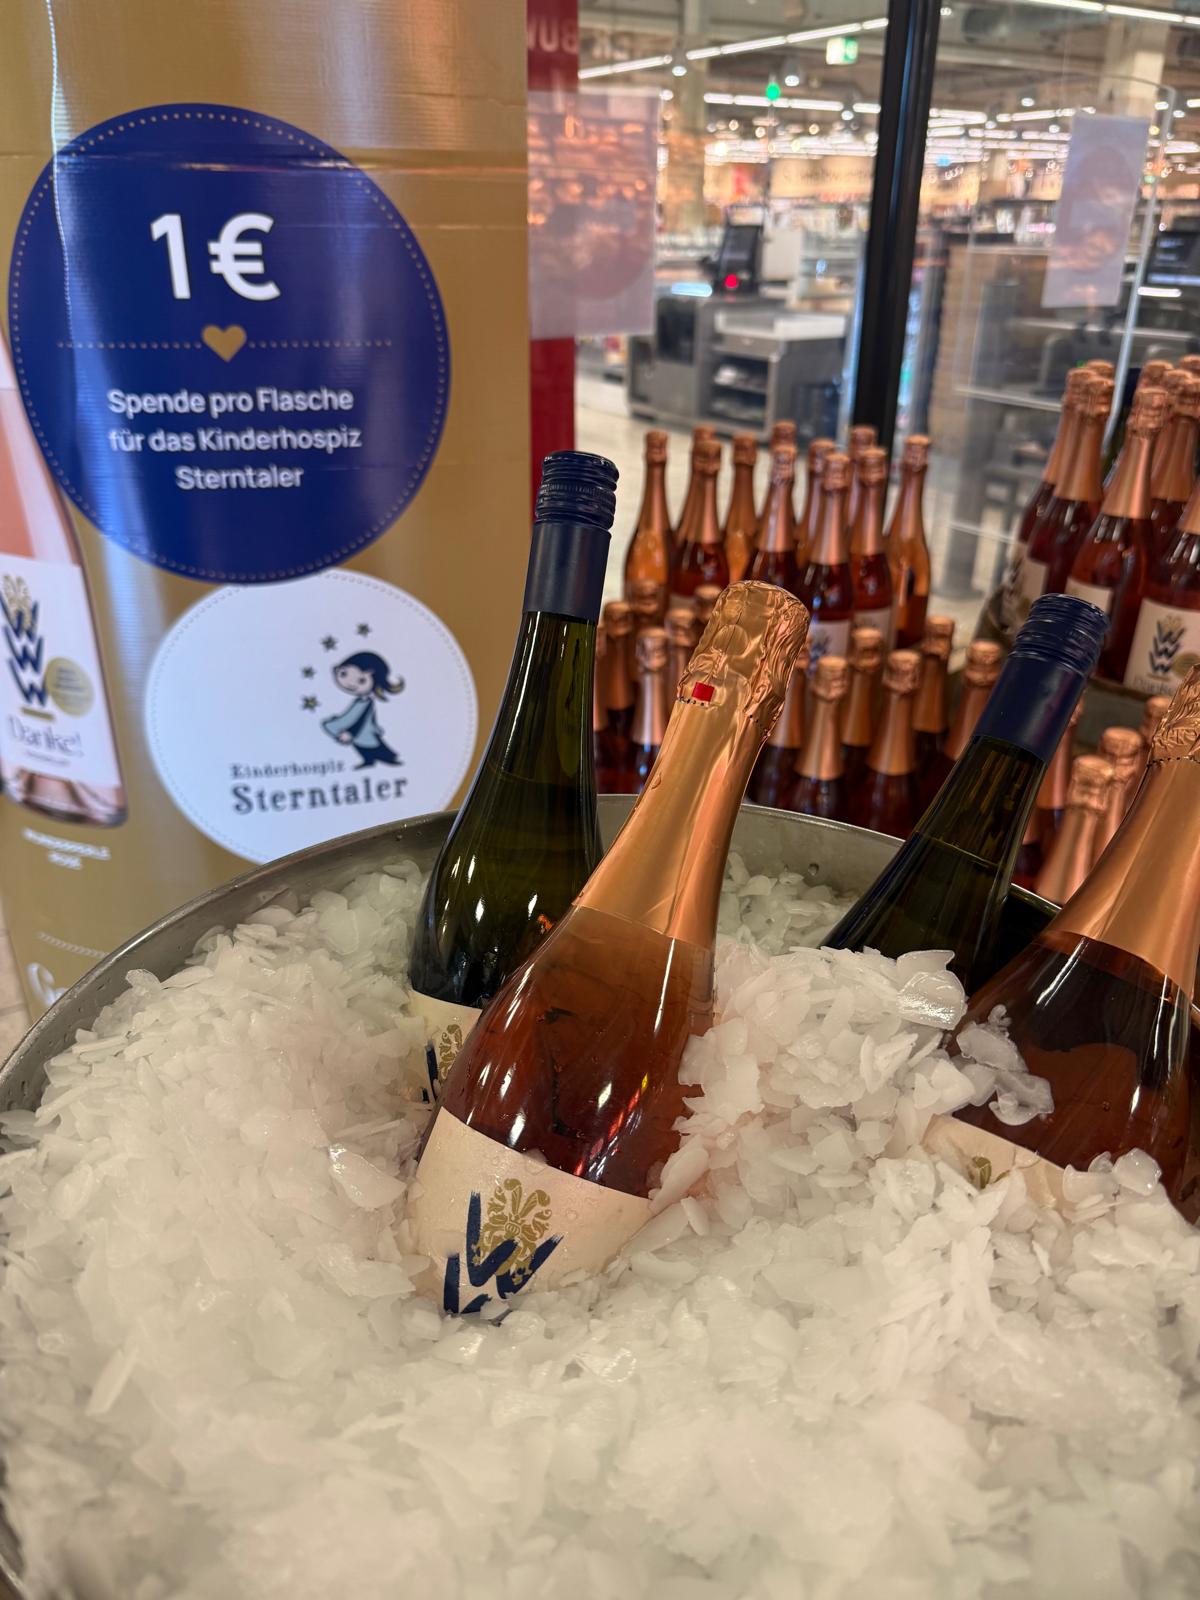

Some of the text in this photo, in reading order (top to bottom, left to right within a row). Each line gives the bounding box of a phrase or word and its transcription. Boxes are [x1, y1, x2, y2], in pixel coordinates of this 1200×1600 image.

[150, 212, 281, 301] 1 €
[107, 385, 354, 419] Spende pro Flasche
[108, 424, 362, 455] für das Kinderhospiz
[175, 464, 304, 490] Sterntaler
[231, 759, 345, 779] Kinderhospiz
[232, 777, 408, 815] Sterntaler
